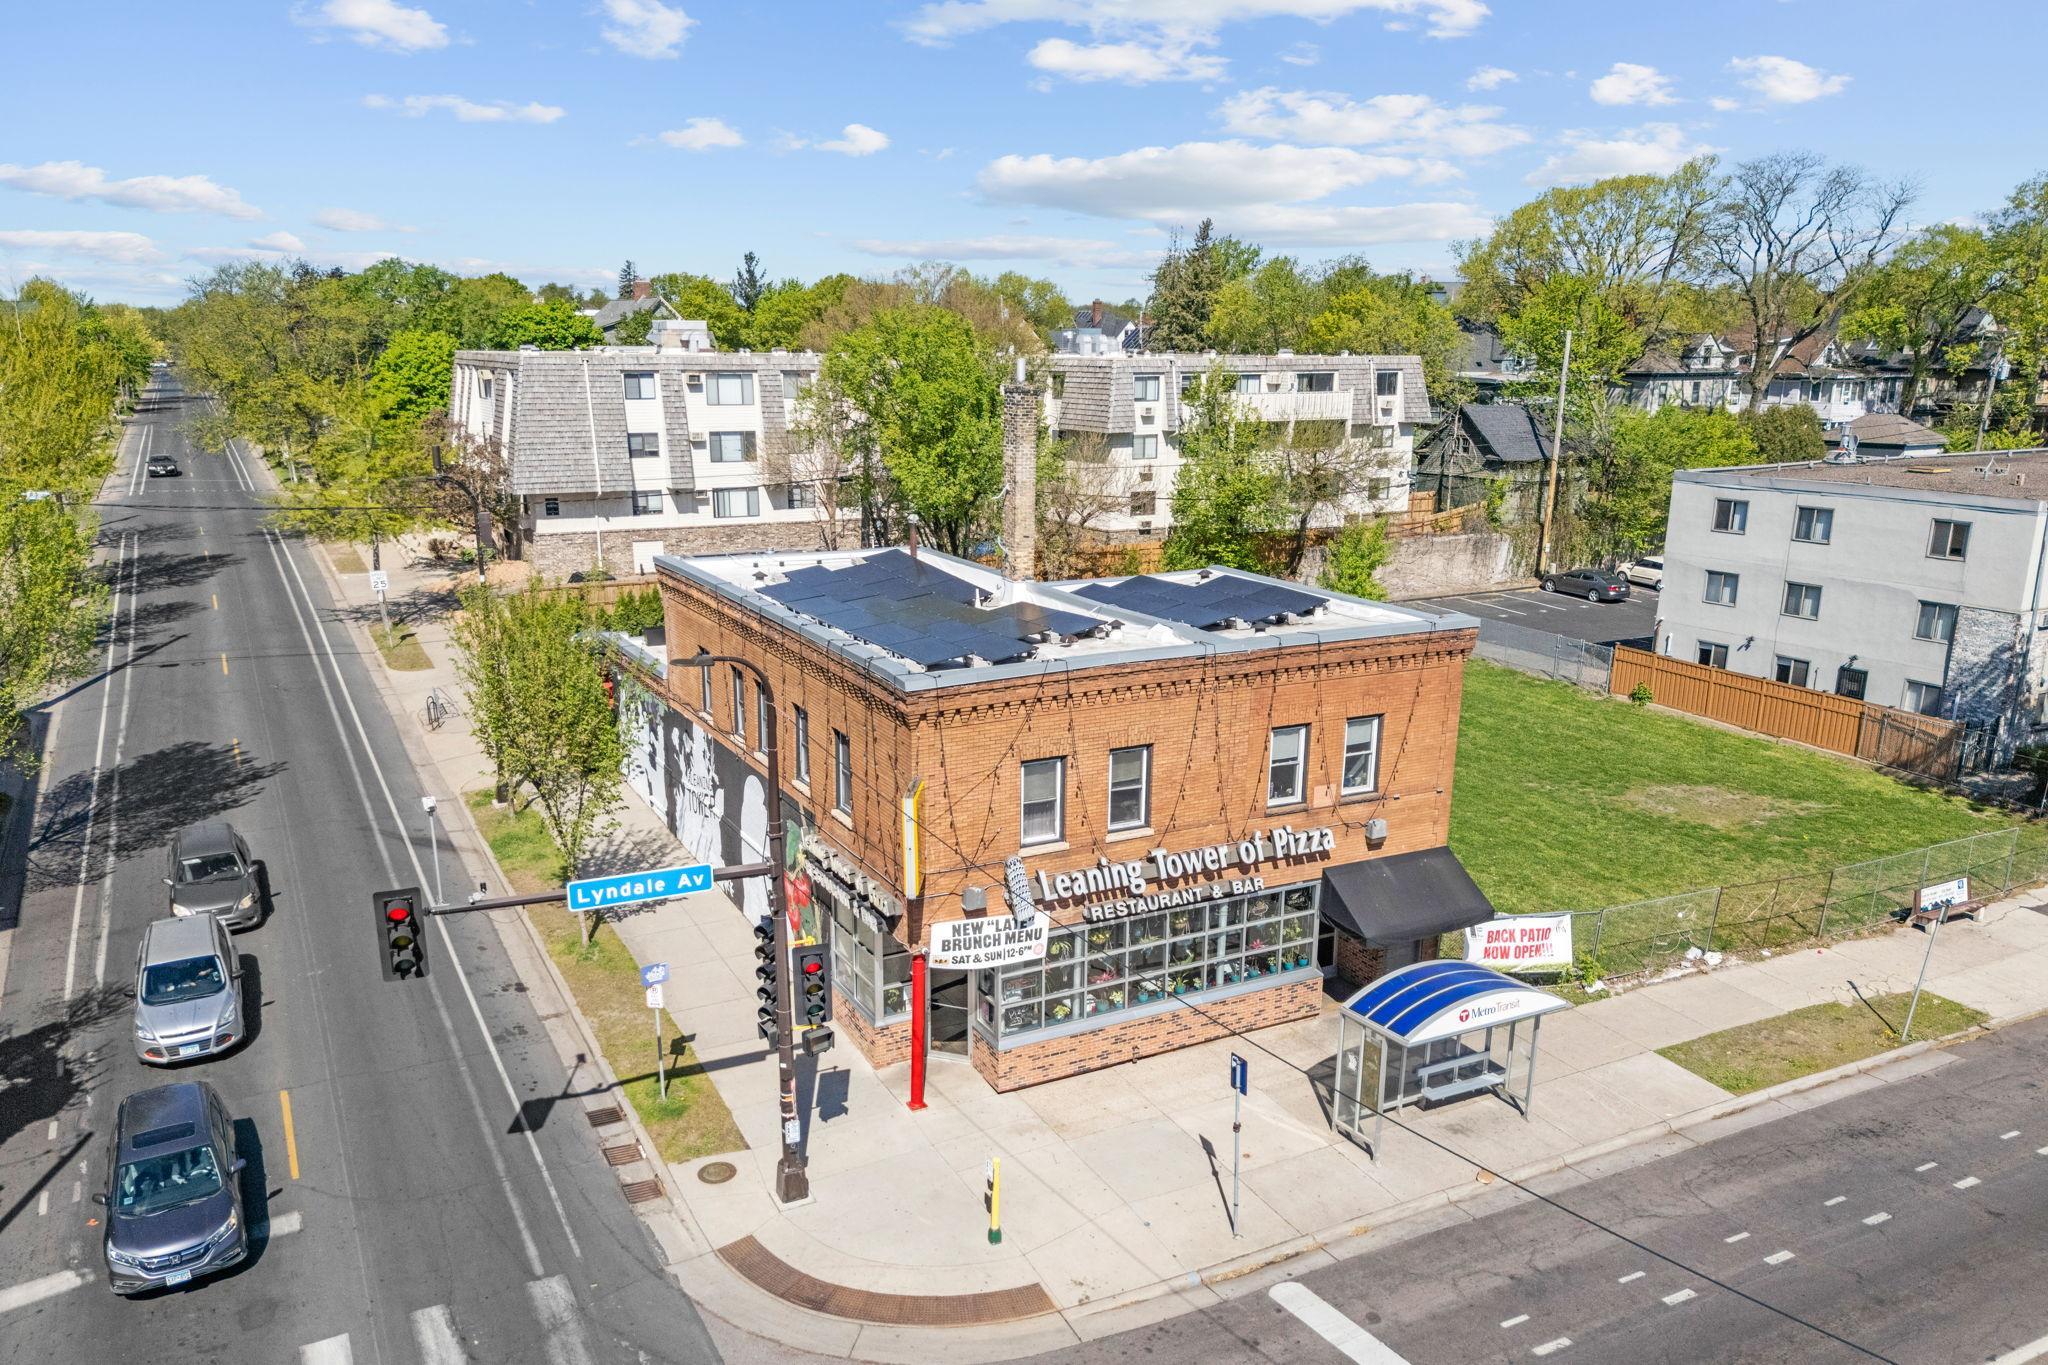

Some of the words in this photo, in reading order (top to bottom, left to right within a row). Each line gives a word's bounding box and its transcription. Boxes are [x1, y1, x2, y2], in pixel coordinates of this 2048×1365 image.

[373, 580, 387, 589] 25
[686, 787, 717, 820] TOWER
[1037, 856, 1147, 901] Leaning
[1151, 846, 1229, 880] Tower
[1239, 830, 1265, 865] of
[1272, 825, 1337, 859] Pizza
[576, 878, 666, 905] Lyndale
[677, 873, 704, 889] Av
[1090, 887, 1204, 921] RESTAURANT
[1212, 885, 1225, 899] &
[1232, 877, 1265, 895] BAR
[941, 933, 1002, 953] BRUNCH
[1004, 927, 1043, 945] MENU
[952, 920, 985, 938] NEW
[1486, 928, 1517, 944] BACK
[1520, 927, 1552, 942] PATIO
[951, 954, 972, 965] SAT
[974, 953, 983, 963] &
[1483, 945, 1513, 960] NOW
[1514, 943, 1554, 959] OPEN!!!
